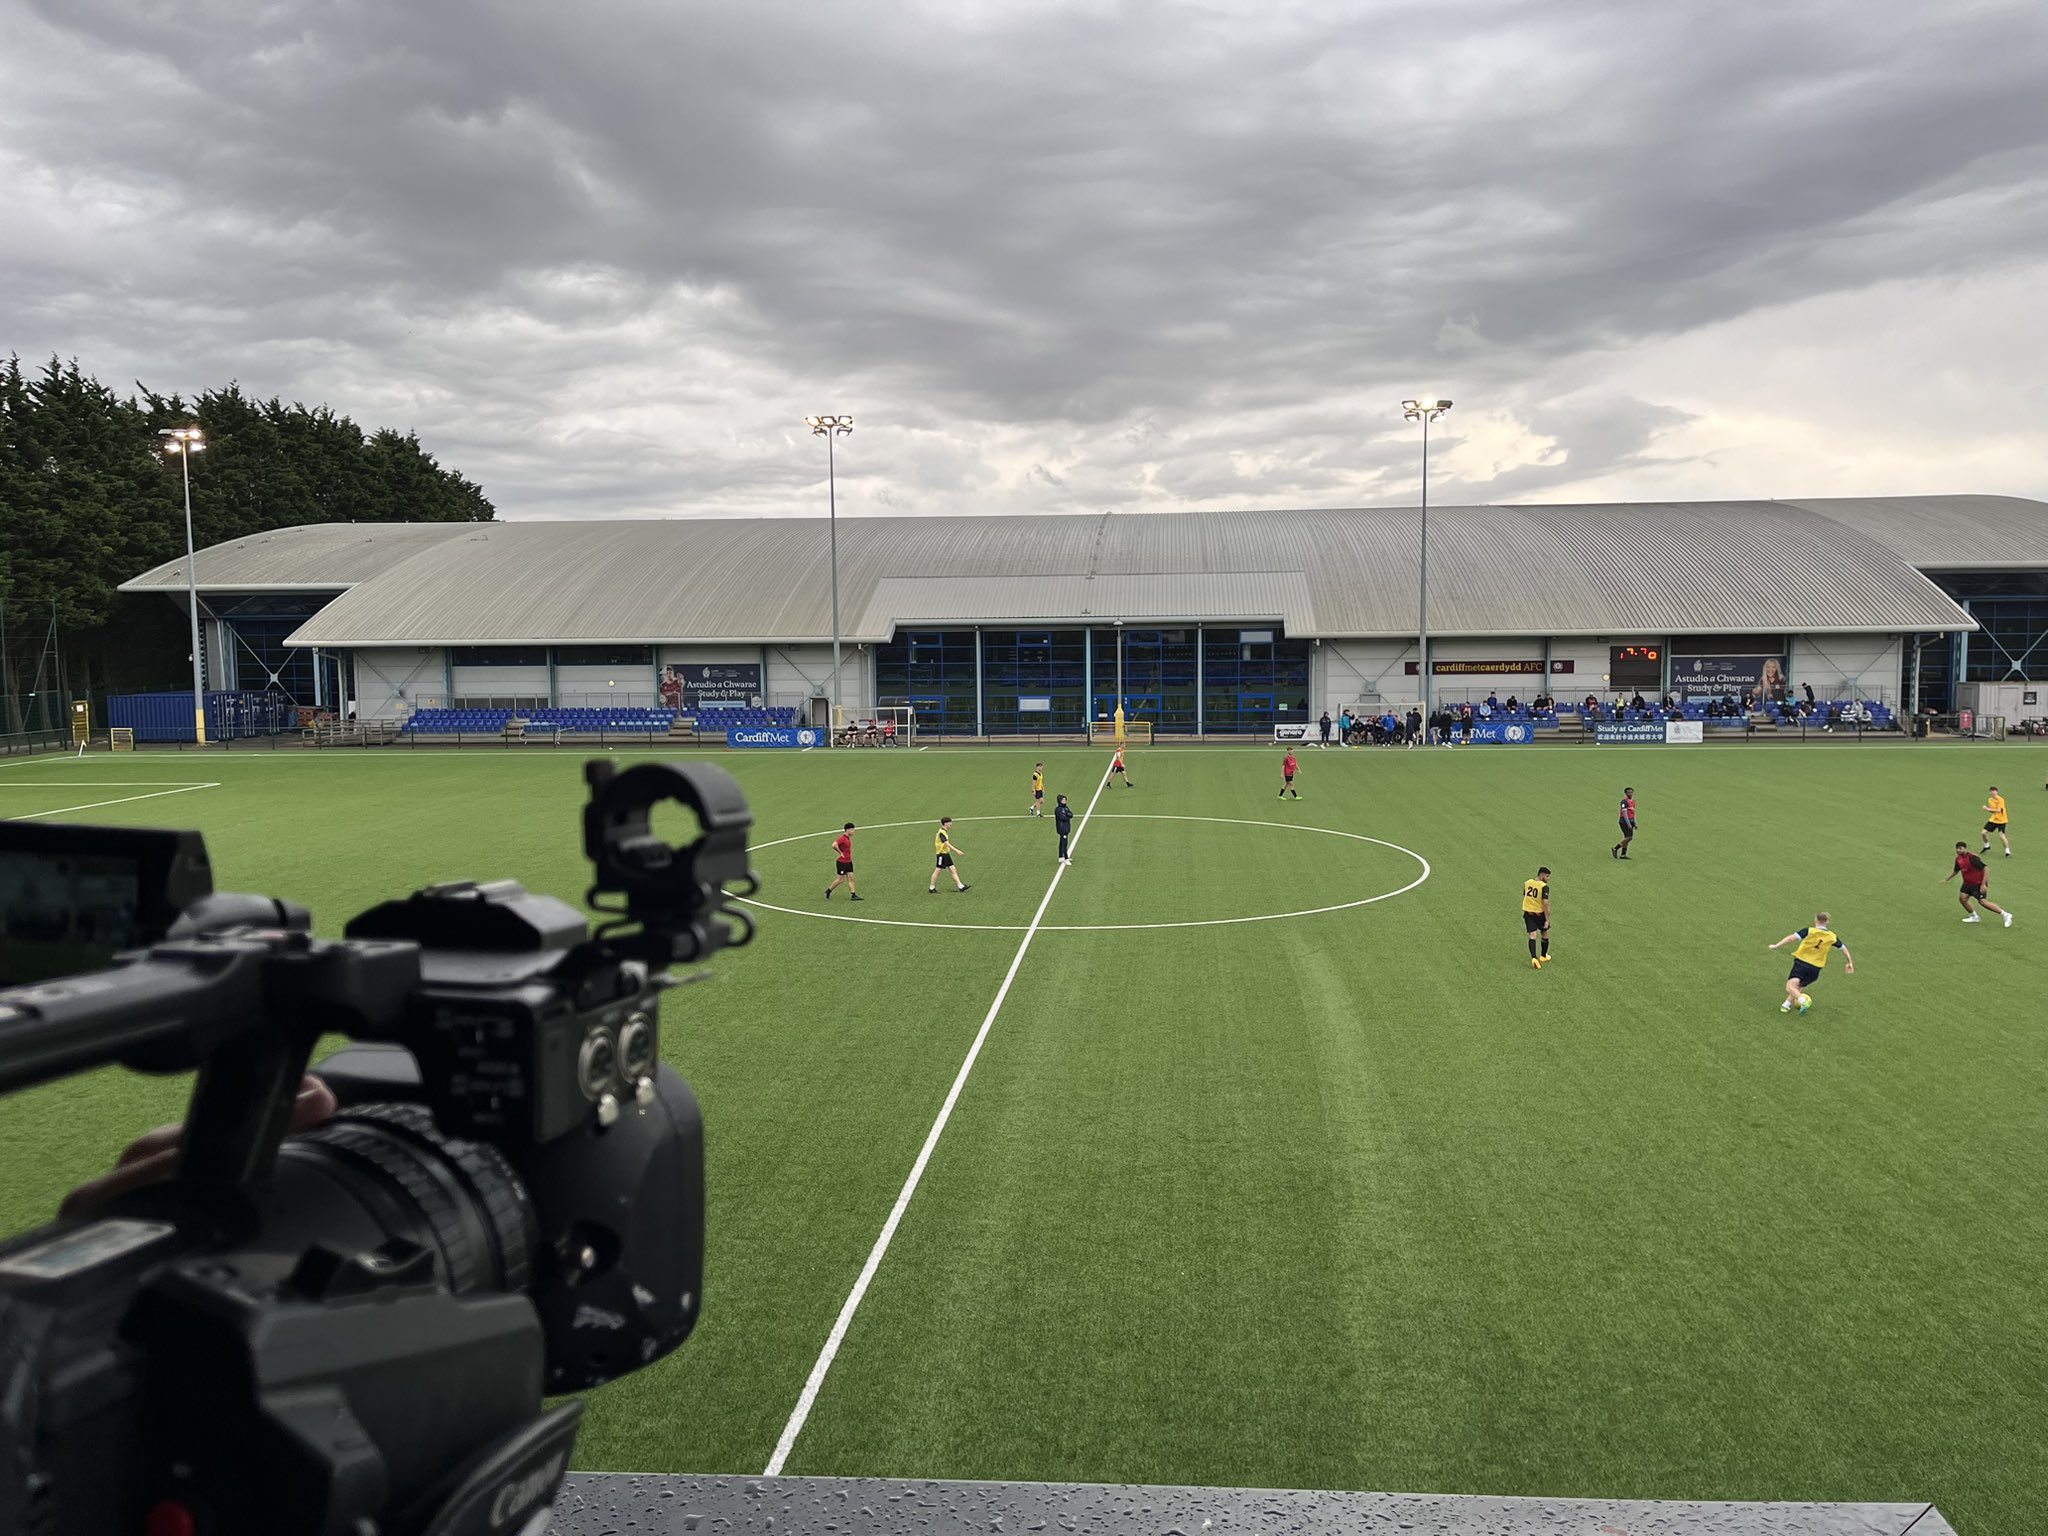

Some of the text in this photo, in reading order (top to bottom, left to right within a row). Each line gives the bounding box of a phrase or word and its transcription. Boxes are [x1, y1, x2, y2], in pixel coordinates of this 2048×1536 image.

[1436, 662, 1542, 673] cardiffmetcaerdydd AFC
[1675, 674, 1708, 682] Astudio
[1716, 674, 1755, 682] Chwarae
[1687, 684, 1741, 693] Study & Play
[698, 690, 719, 698] Study
[729, 690, 745, 698] Play
[1597, 725, 1618, 733] Study
[1527, 886, 1538, 898] 20
